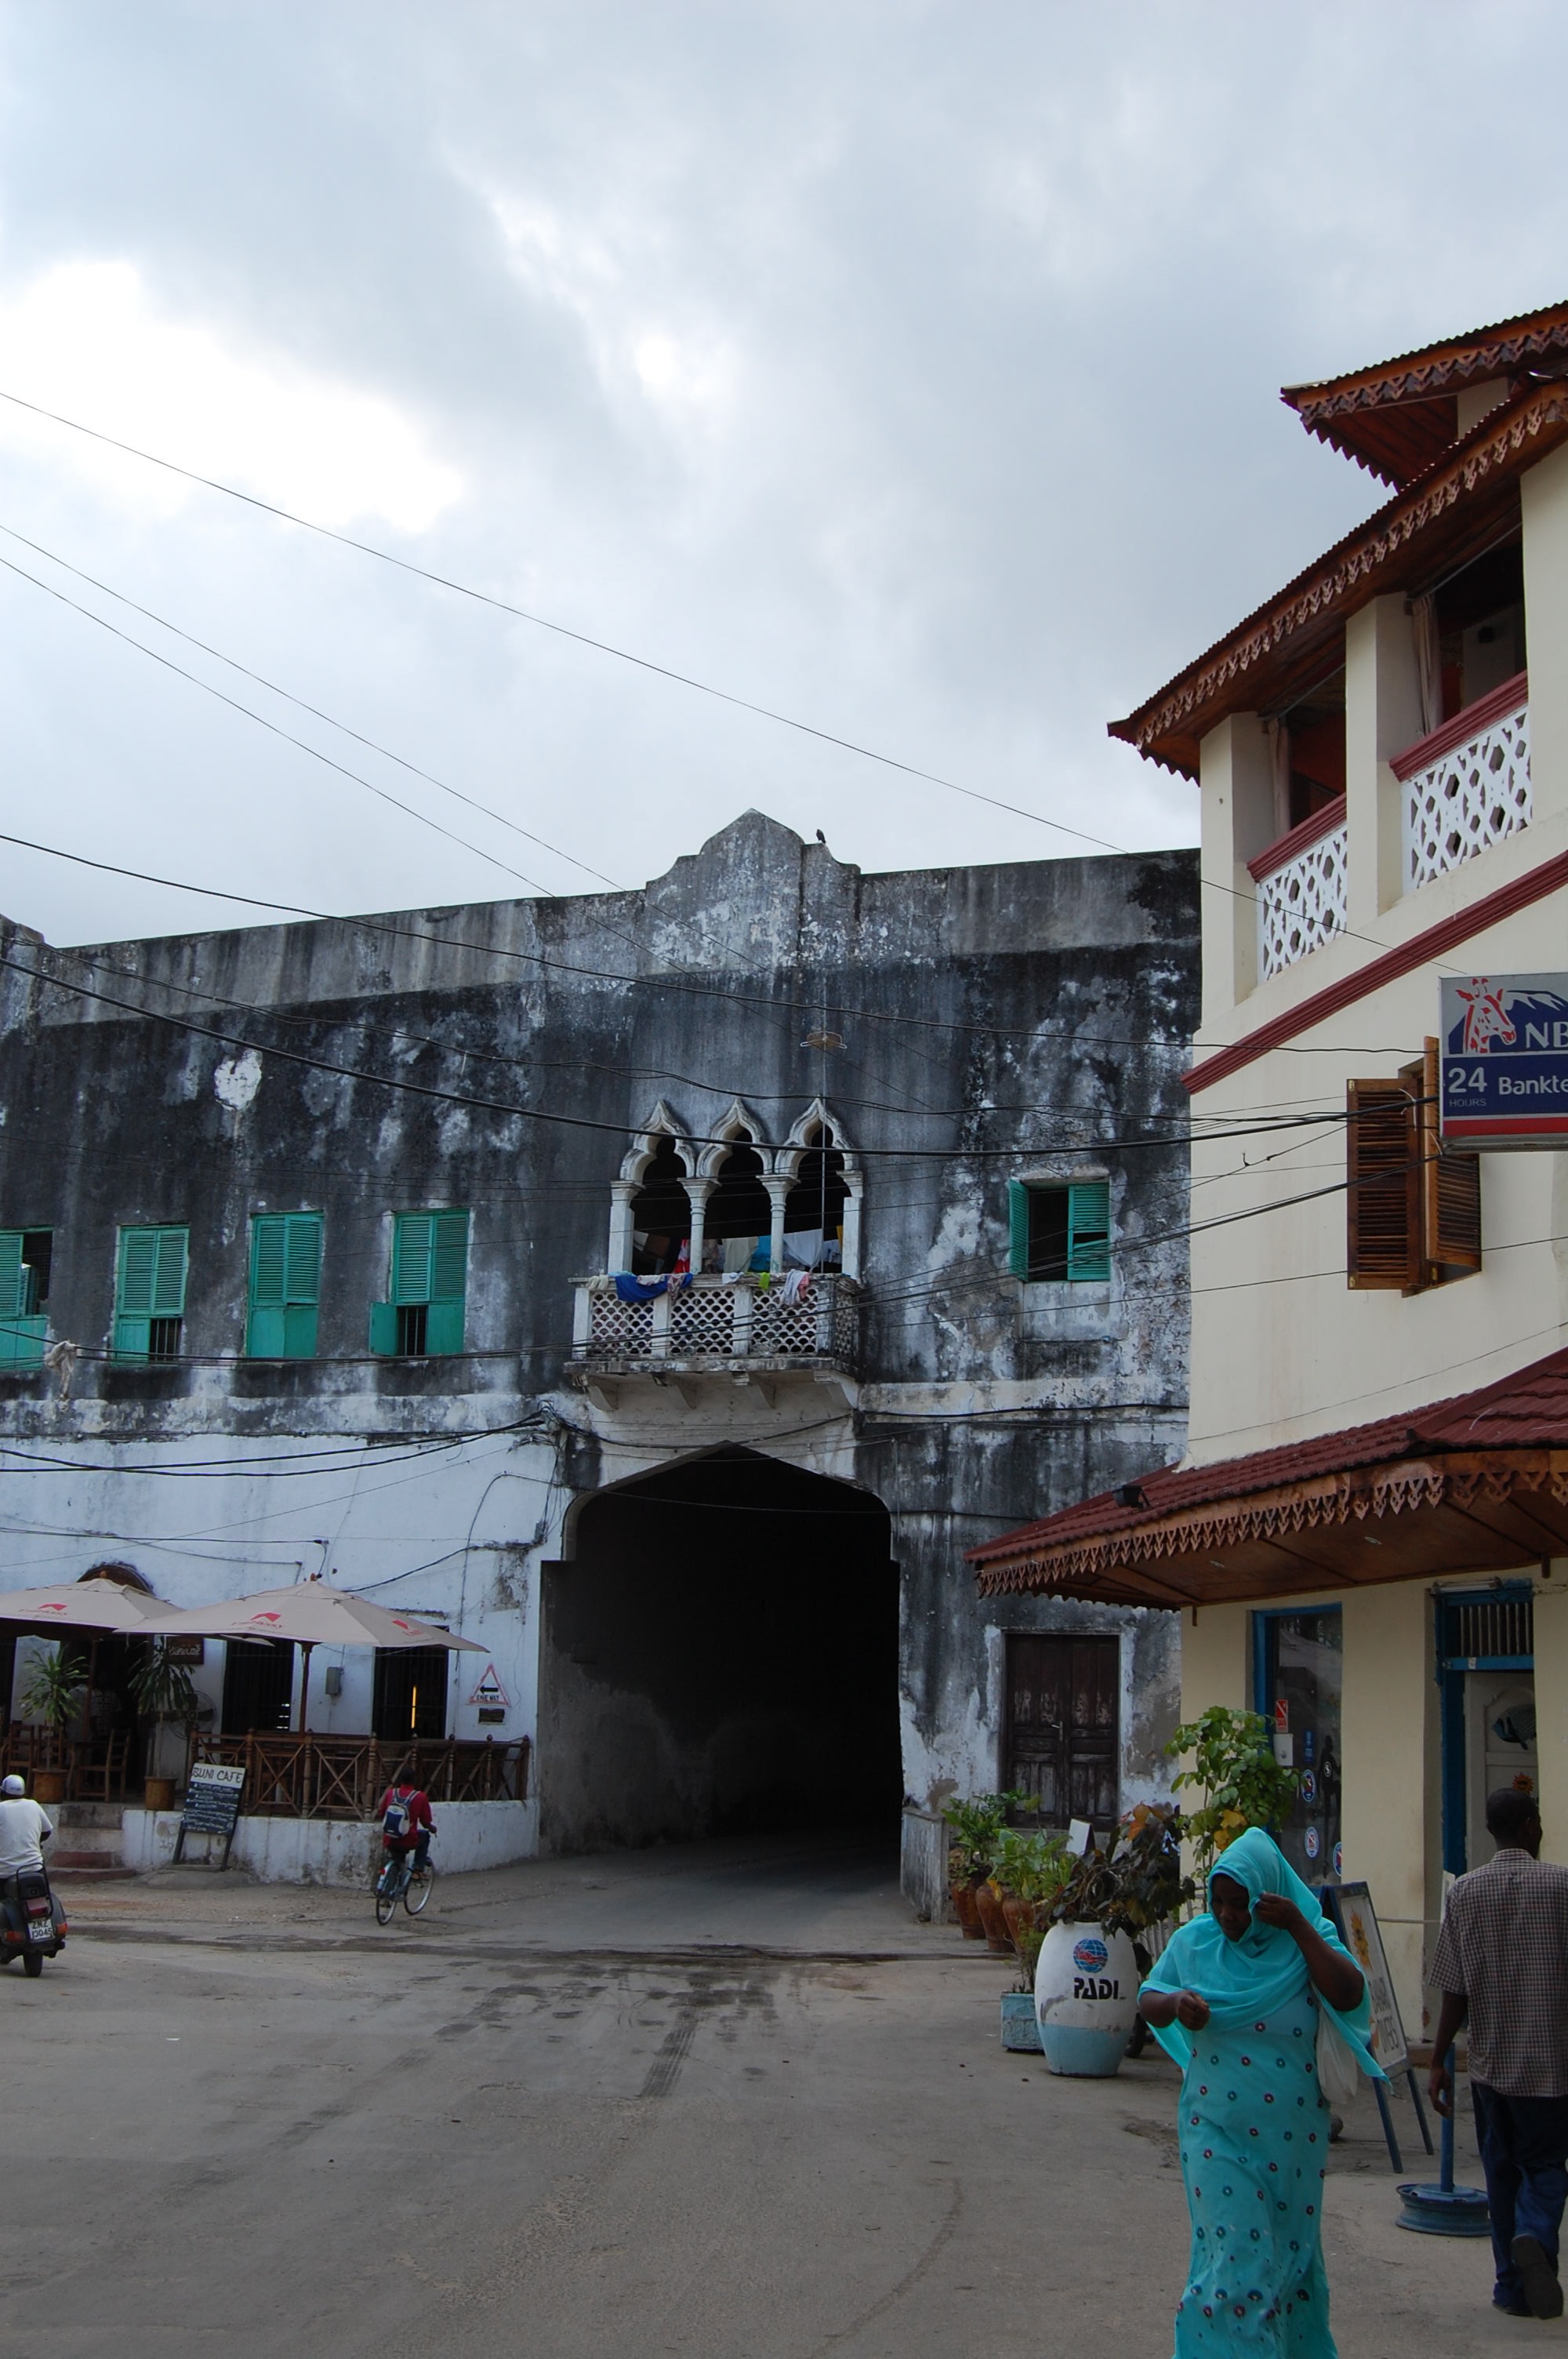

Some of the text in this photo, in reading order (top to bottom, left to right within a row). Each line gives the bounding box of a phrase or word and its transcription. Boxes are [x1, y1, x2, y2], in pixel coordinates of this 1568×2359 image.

[1448, 1067, 1487, 1093] 24
[1449, 1098, 1487, 1107] HOURS
[192, 1767, 243, 1783] BUNI CAFE
[28, 1919, 49, 1929] ZNZ
[1073, 1977, 1119, 2000] PADI
